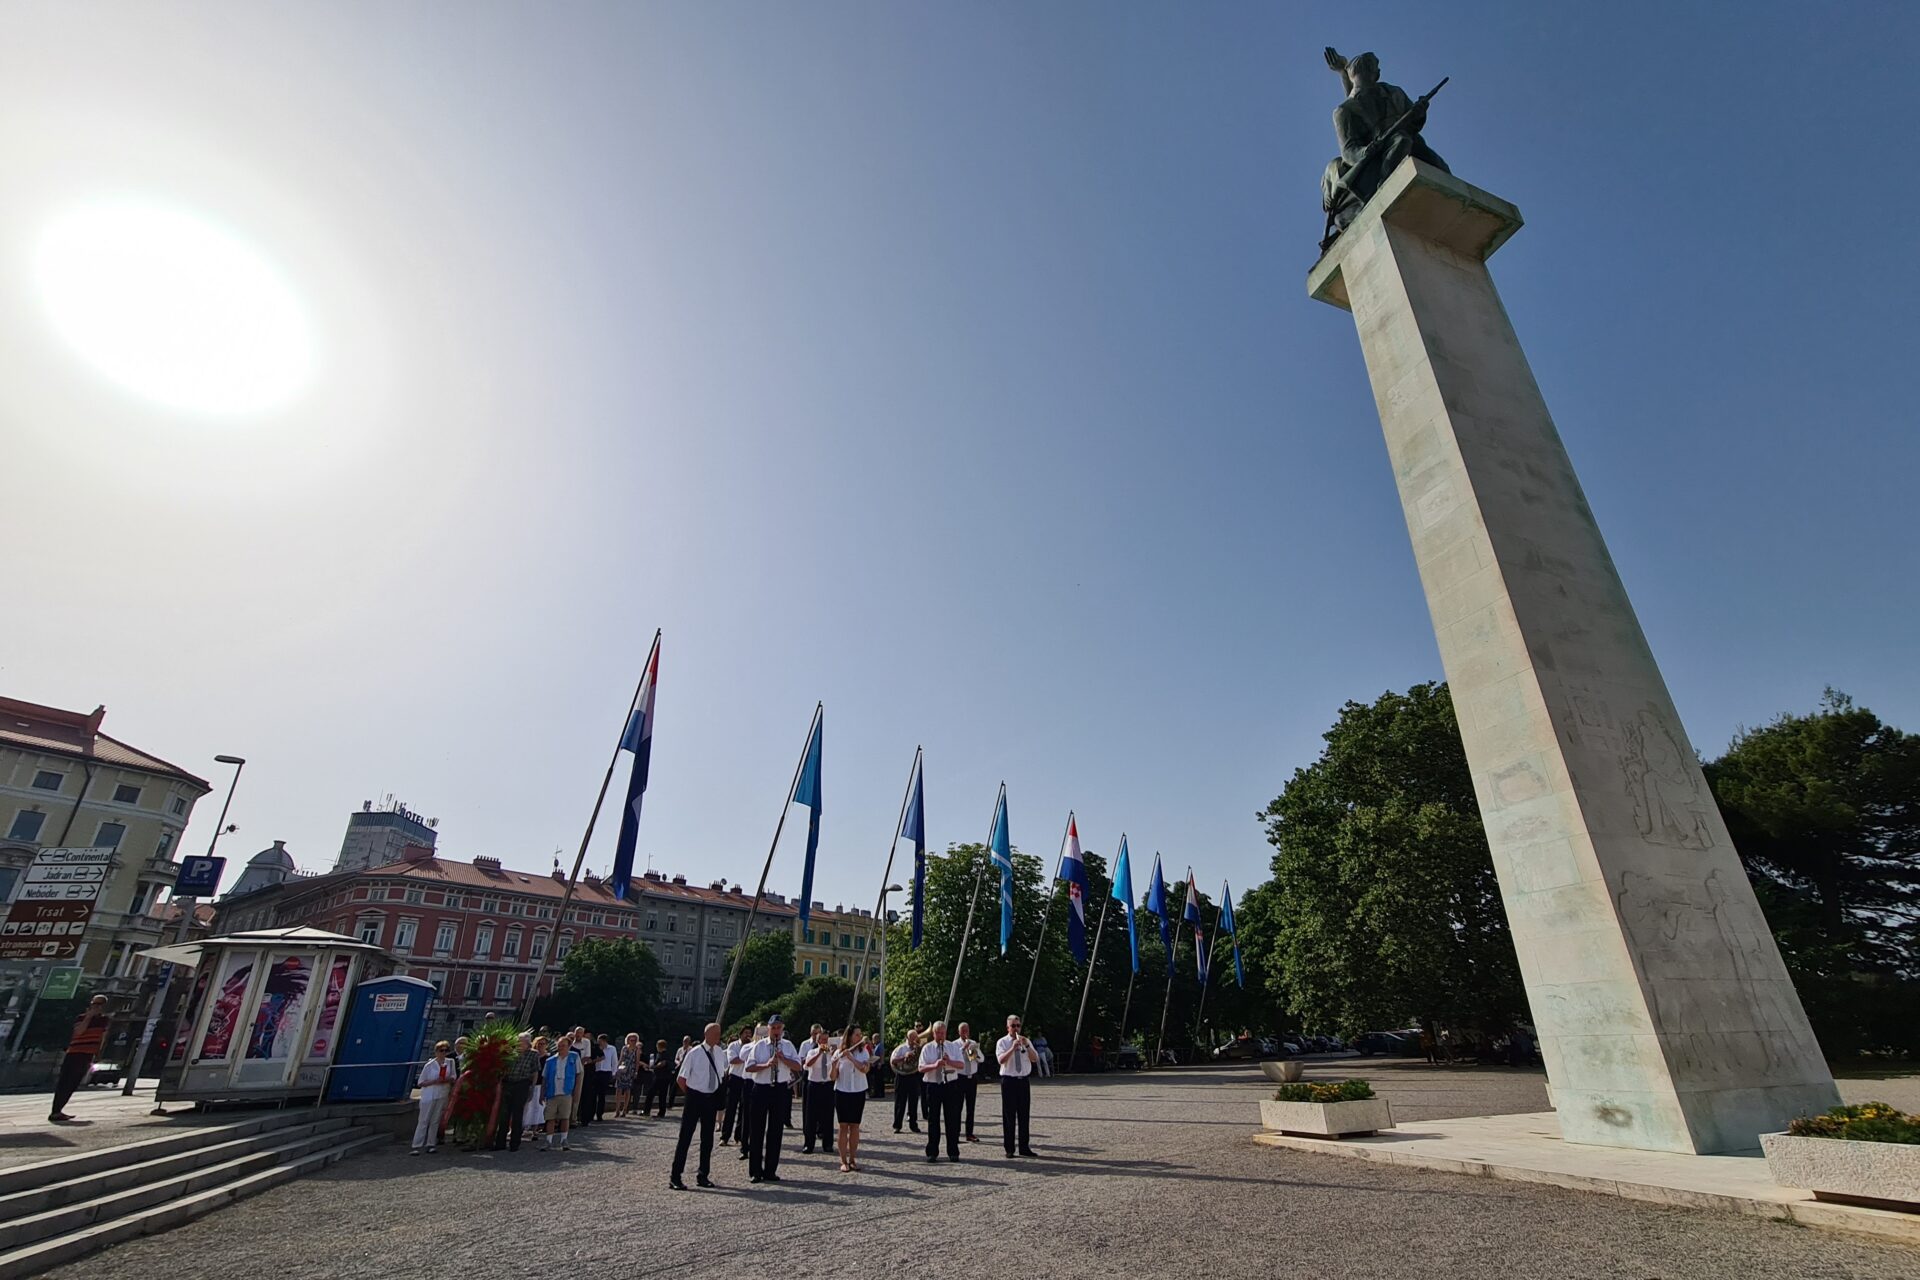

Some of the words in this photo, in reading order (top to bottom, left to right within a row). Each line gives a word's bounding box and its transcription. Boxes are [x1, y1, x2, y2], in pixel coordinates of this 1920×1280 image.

[401, 808, 424, 826] HOTEL
[66, 852, 112, 861] Continental
[190, 860, 213, 877] P
[43, 871, 72, 880] Jadran
[25, 889, 59, 898] Neboder
[36, 906, 65, 917] Trsat
[0, 940, 45, 949] stronomski
